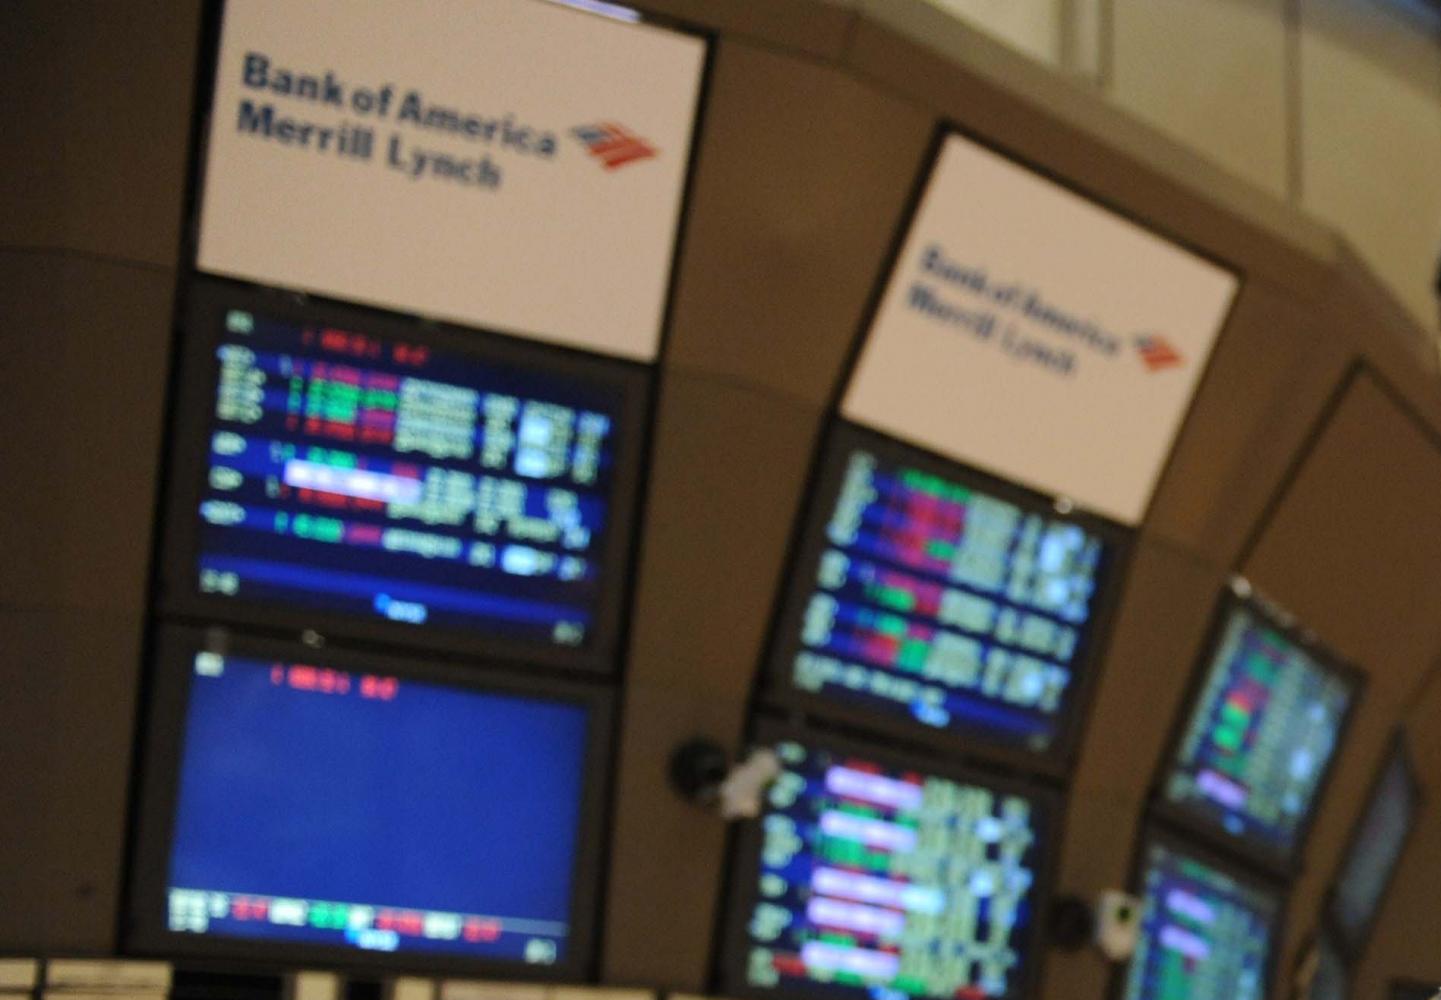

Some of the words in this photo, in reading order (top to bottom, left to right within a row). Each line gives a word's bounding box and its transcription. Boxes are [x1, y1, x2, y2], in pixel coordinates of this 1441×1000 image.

[236, 100, 373, 161] Merrill
[386, 134, 502, 190] Lynch
[241, 51, 343, 109] Bank
[351, 84, 395, 119] of
[399, 91, 556, 158] America
